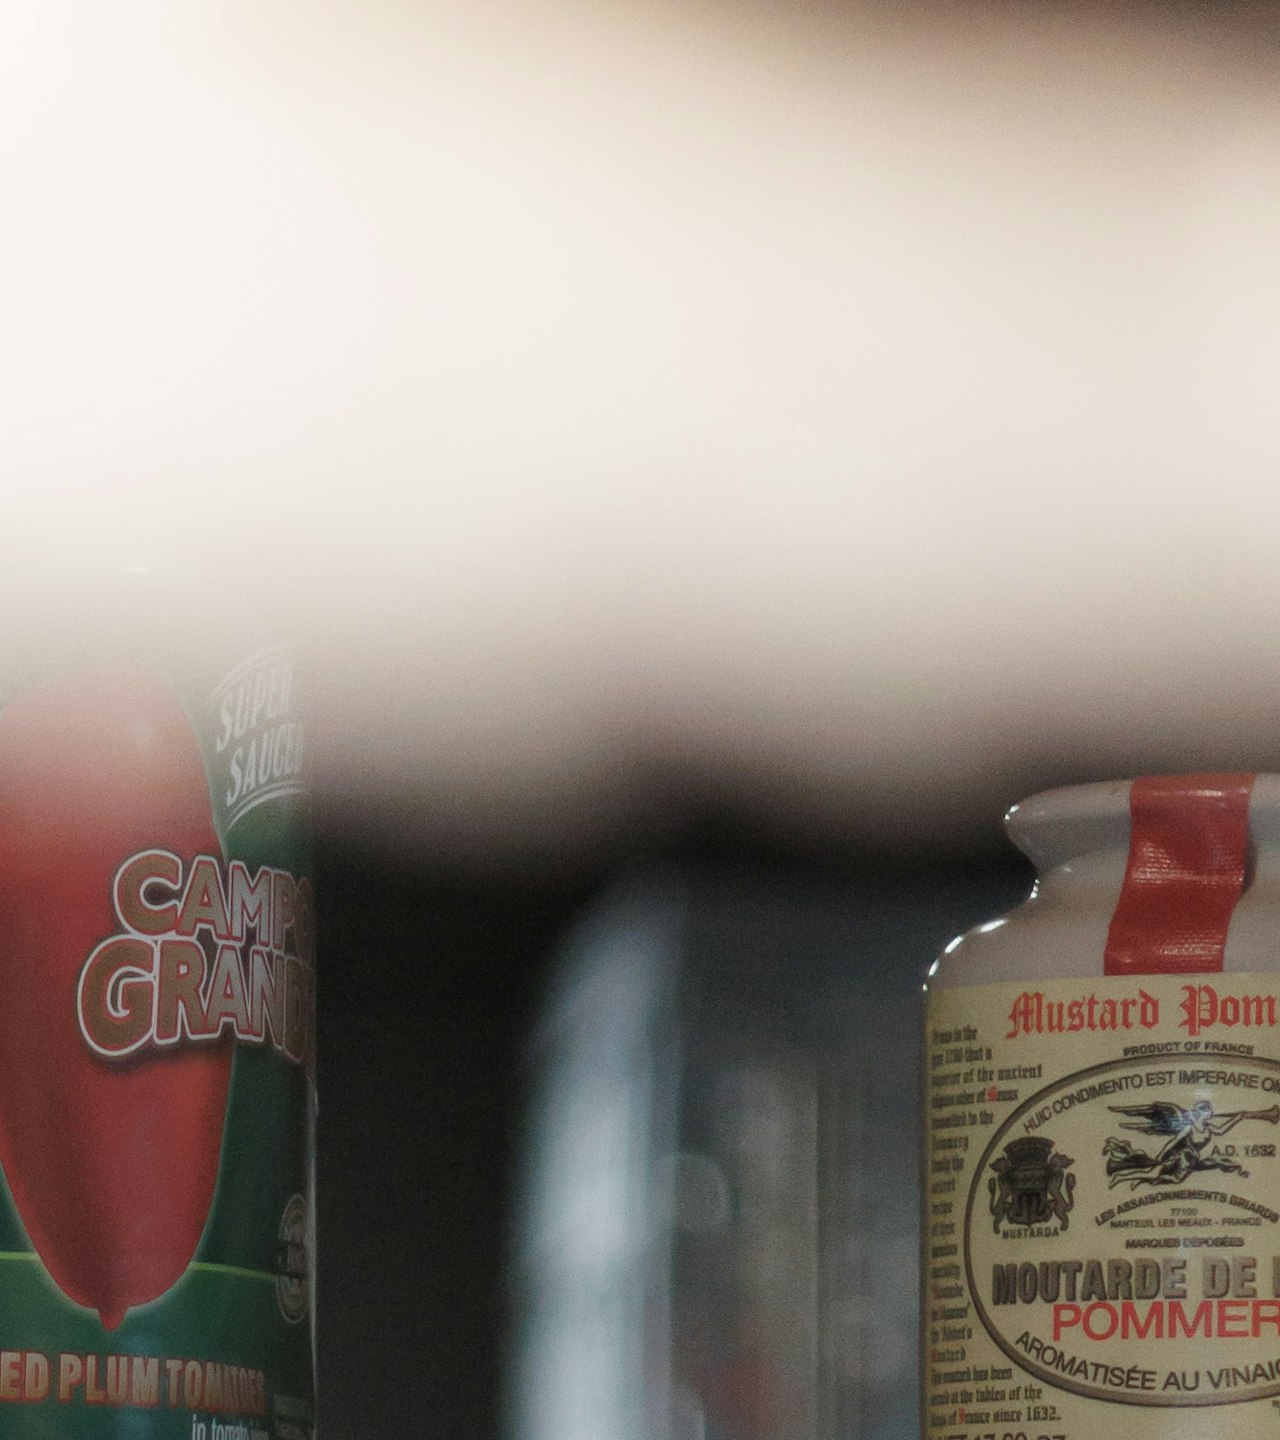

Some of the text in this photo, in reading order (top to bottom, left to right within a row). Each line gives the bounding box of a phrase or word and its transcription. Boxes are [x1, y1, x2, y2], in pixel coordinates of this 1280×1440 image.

[1004, 989, 1161, 1040] Mustard
[1122, 1041, 1256, 1057] PRODUCT OF FRANCE
[1049, 1073, 1144, 1116] CONDIMENTO
[1145, 1070, 1175, 1088] EST
[1178, 1069, 1259, 1089] IMPERARE
[1002, 1227, 1061, 1240] MUSTARDA
[992, 1255, 1258, 1306] MOUTARDE DE
[58, 1353, 162, 1407] PLUM
[1014, 1329, 1158, 1392] AROMATISÉE
[1162, 1370, 1200, 1392] AU
[1025, 1405, 1062, 1422] 1632.
